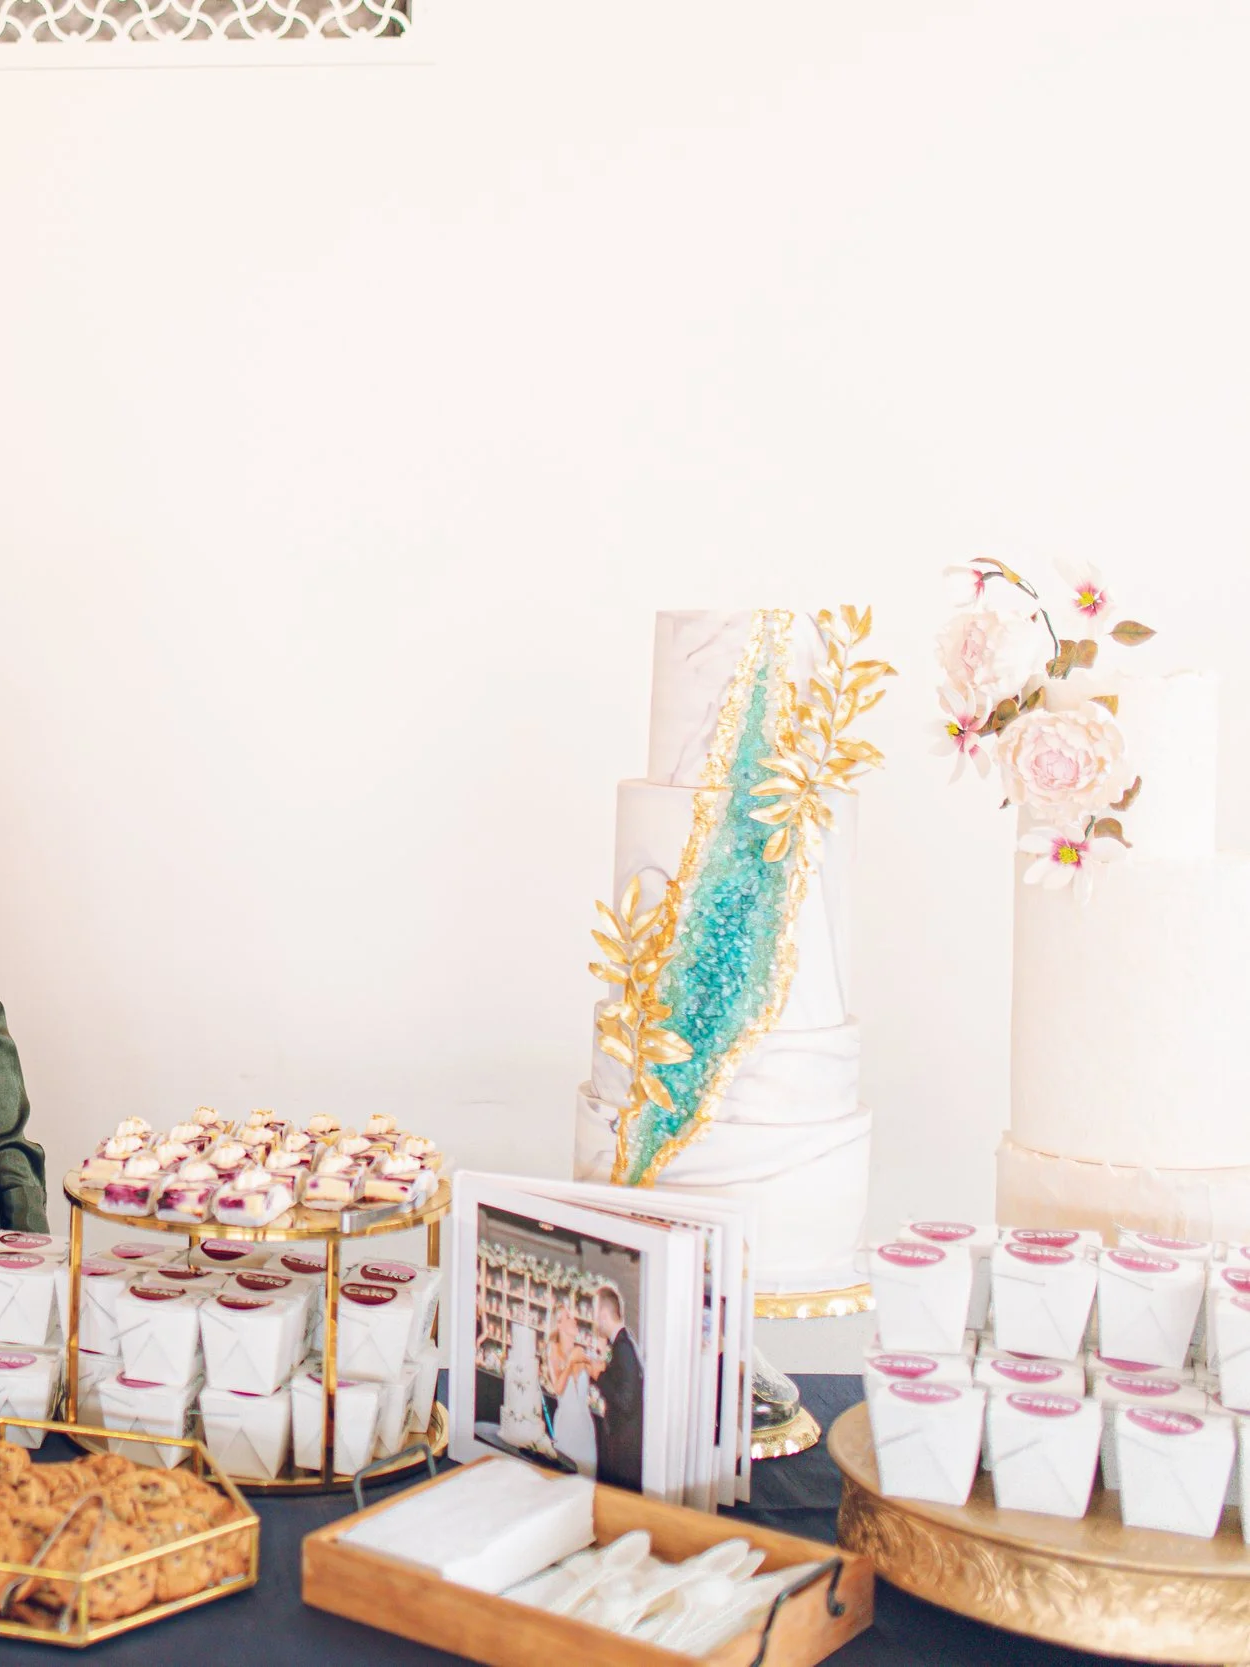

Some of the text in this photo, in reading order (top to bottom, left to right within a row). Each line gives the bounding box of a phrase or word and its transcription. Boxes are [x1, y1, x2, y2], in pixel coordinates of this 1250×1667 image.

[914, 1224, 970, 1235] Cake
[1020, 1231, 1074, 1239] Cake
[3, 1234, 48, 1244] Cake
[882, 1245, 939, 1261] Cake
[1010, 1244, 1069, 1258] Cake
[1113, 1251, 1174, 1269] Cake
[242, 1272, 285, 1286] Cake
[366, 1265, 411, 1281] Cake
[343, 1285, 393, 1299] Cake
[873, 1358, 933, 1369] Cake
[998, 1361, 1058, 1375] Cake
[1111, 1376, 1177, 1389] Cake
[1011, 1393, 1076, 1410] Cake
